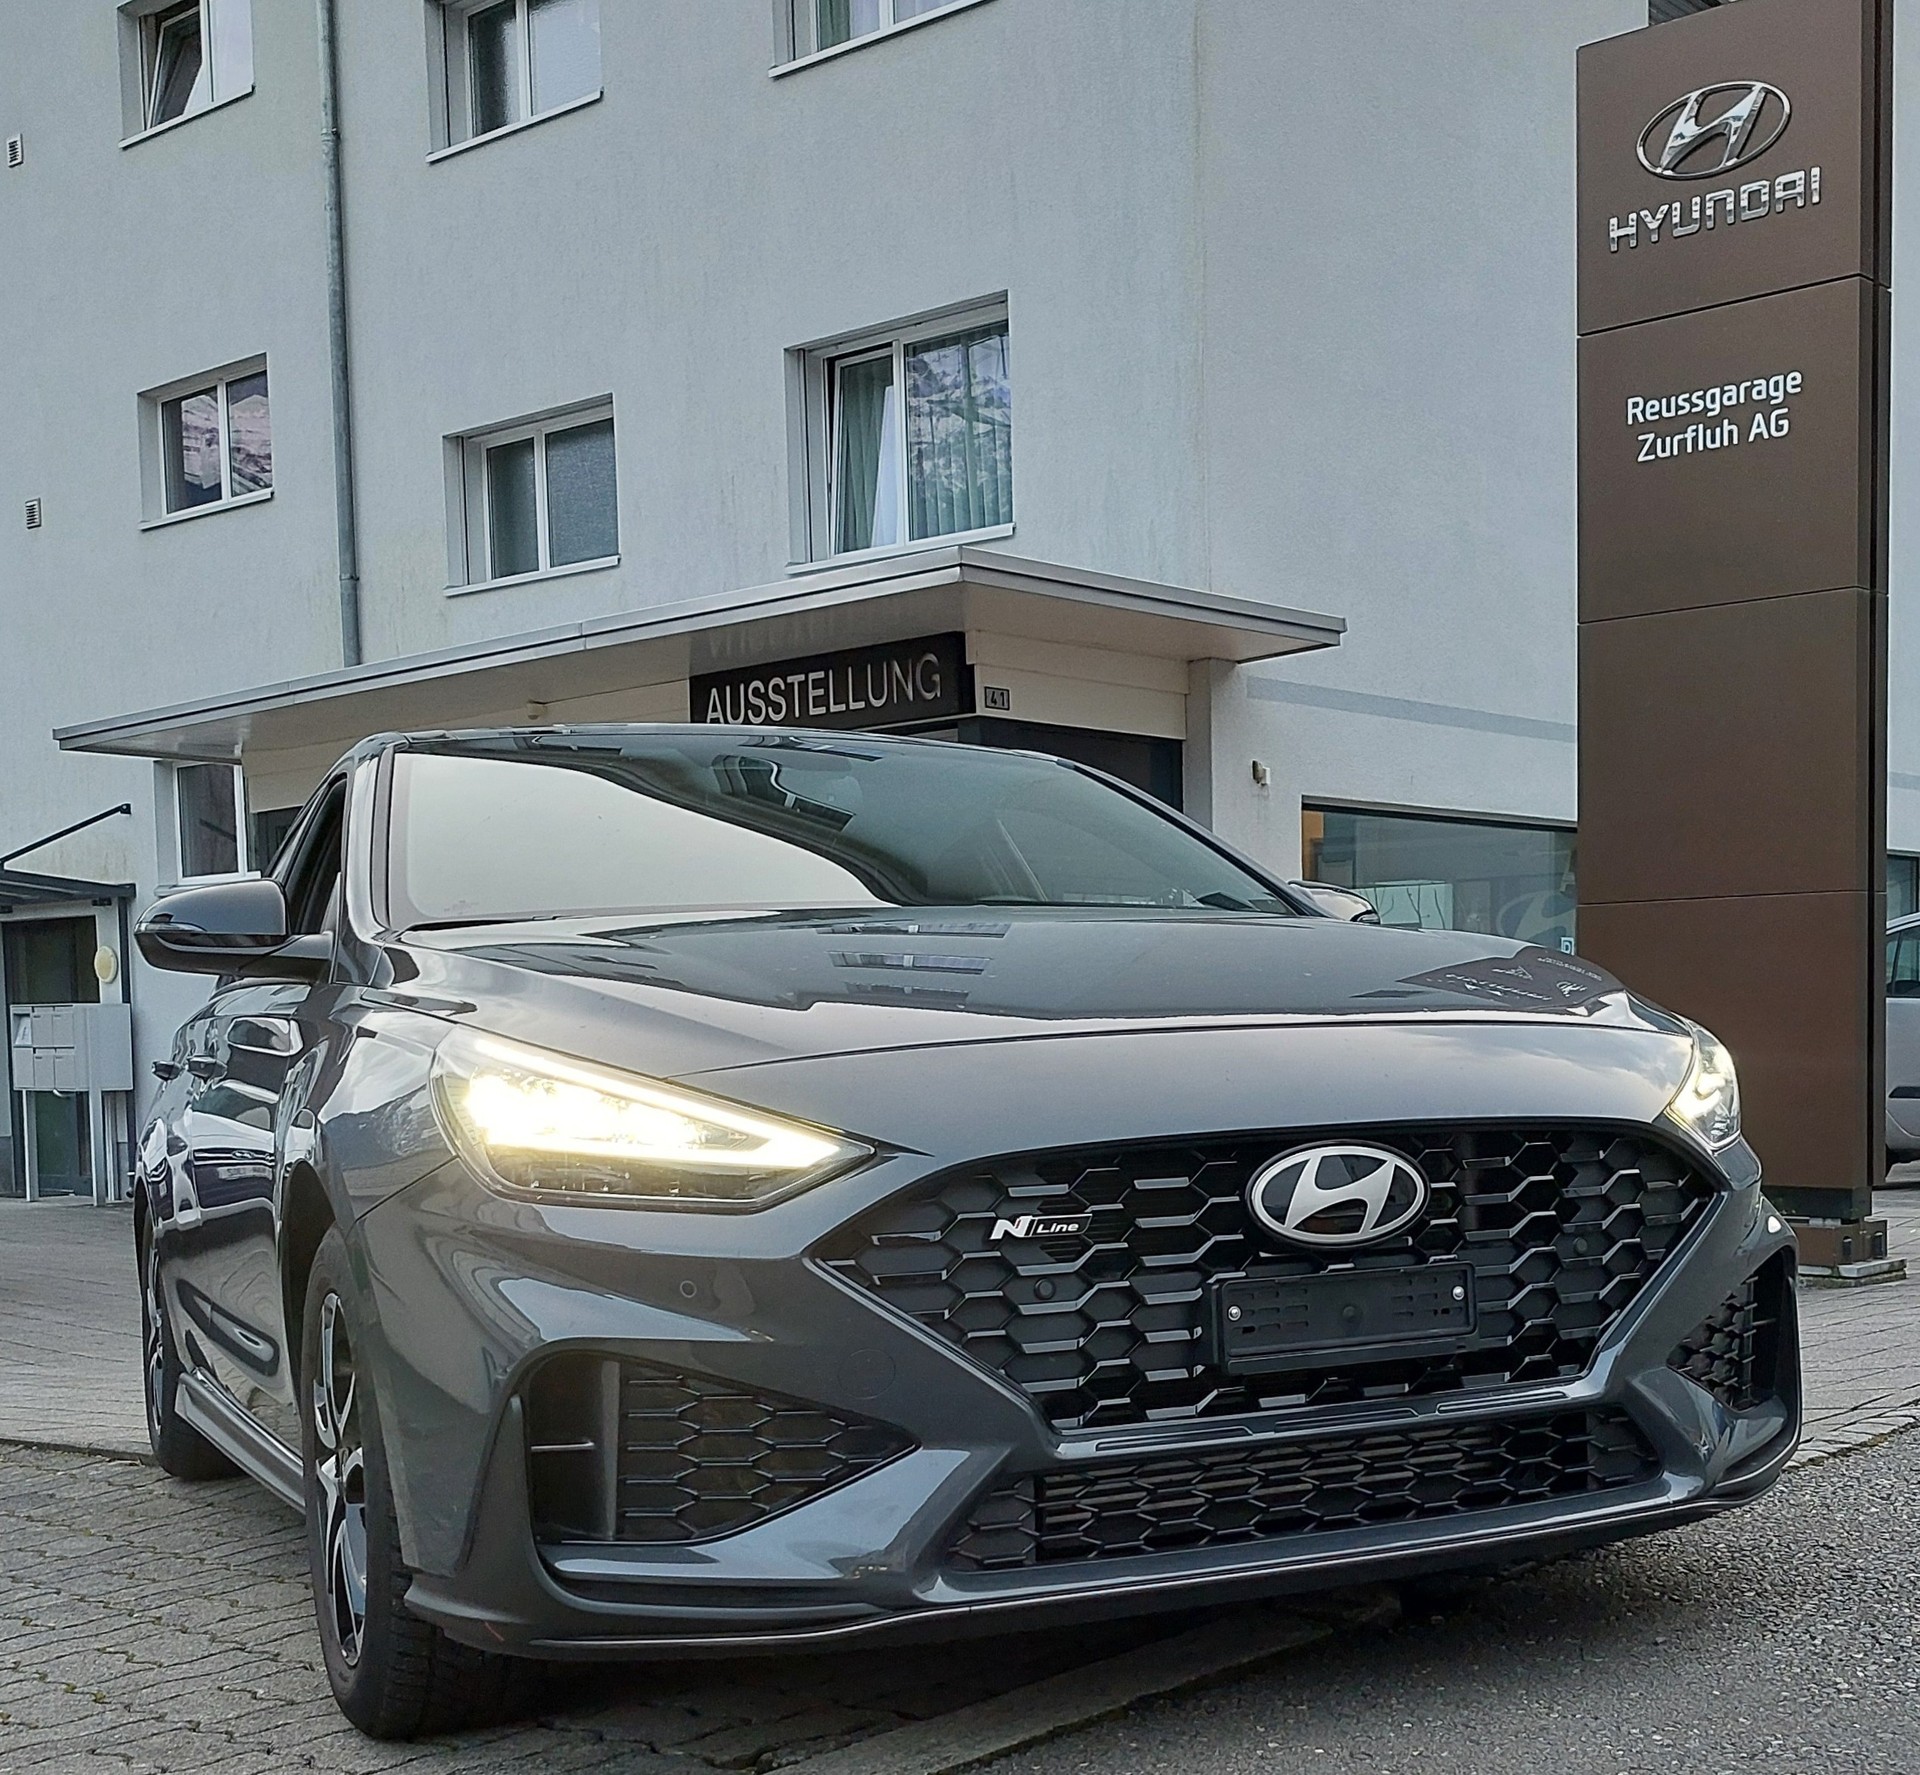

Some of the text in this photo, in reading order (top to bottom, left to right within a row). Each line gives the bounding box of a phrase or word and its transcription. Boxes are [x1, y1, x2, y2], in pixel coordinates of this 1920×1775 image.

[1608, 166, 1821, 252] HYUNDAI
[1627, 371, 1803, 425] Reussgarage
[1637, 407, 1790, 463] Zurfluh AG
[706, 652, 942, 725] AUSSTELLUNG
[990, 690, 1005, 707] 41
[990, 1215, 1079, 1240] N Line
